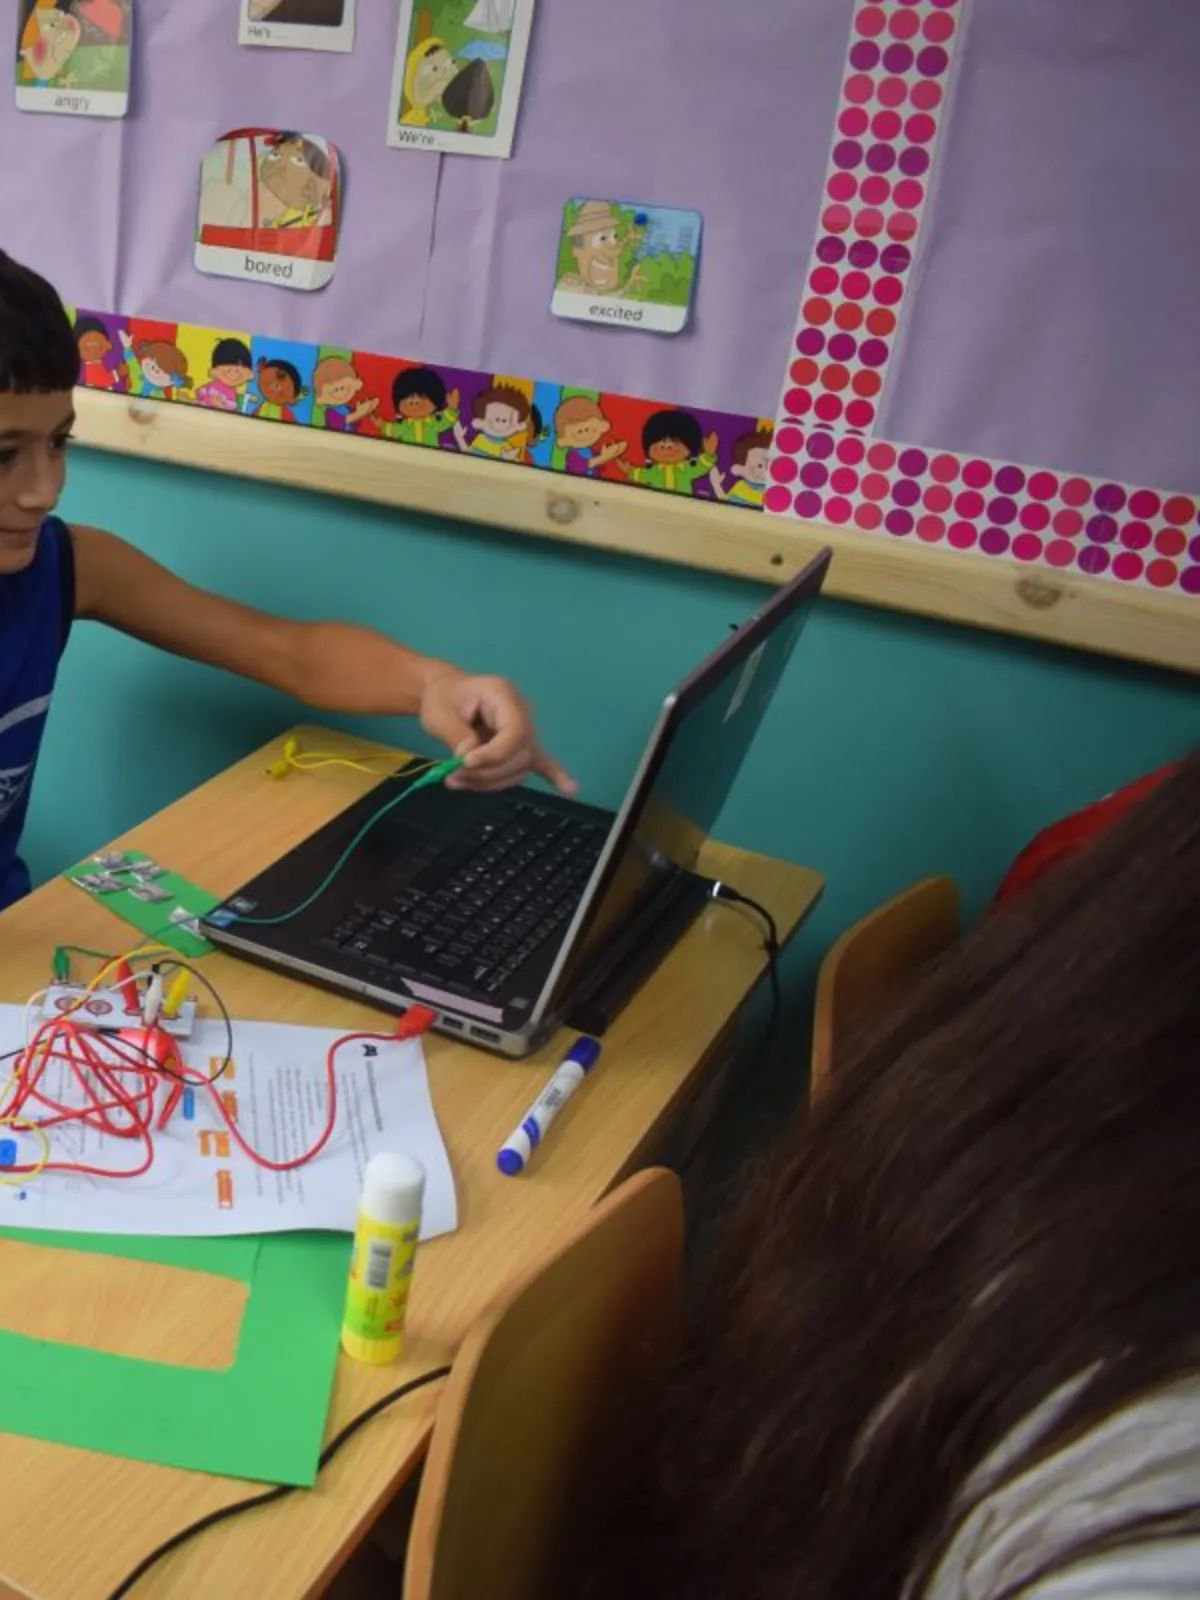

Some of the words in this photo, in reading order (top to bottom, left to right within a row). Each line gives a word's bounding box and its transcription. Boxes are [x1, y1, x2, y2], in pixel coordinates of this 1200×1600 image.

[53, 96, 91, 112] angry
[398, 130, 435, 145] We're
[244, 255, 293, 279] bored
[588, 304, 643, 321] excited
